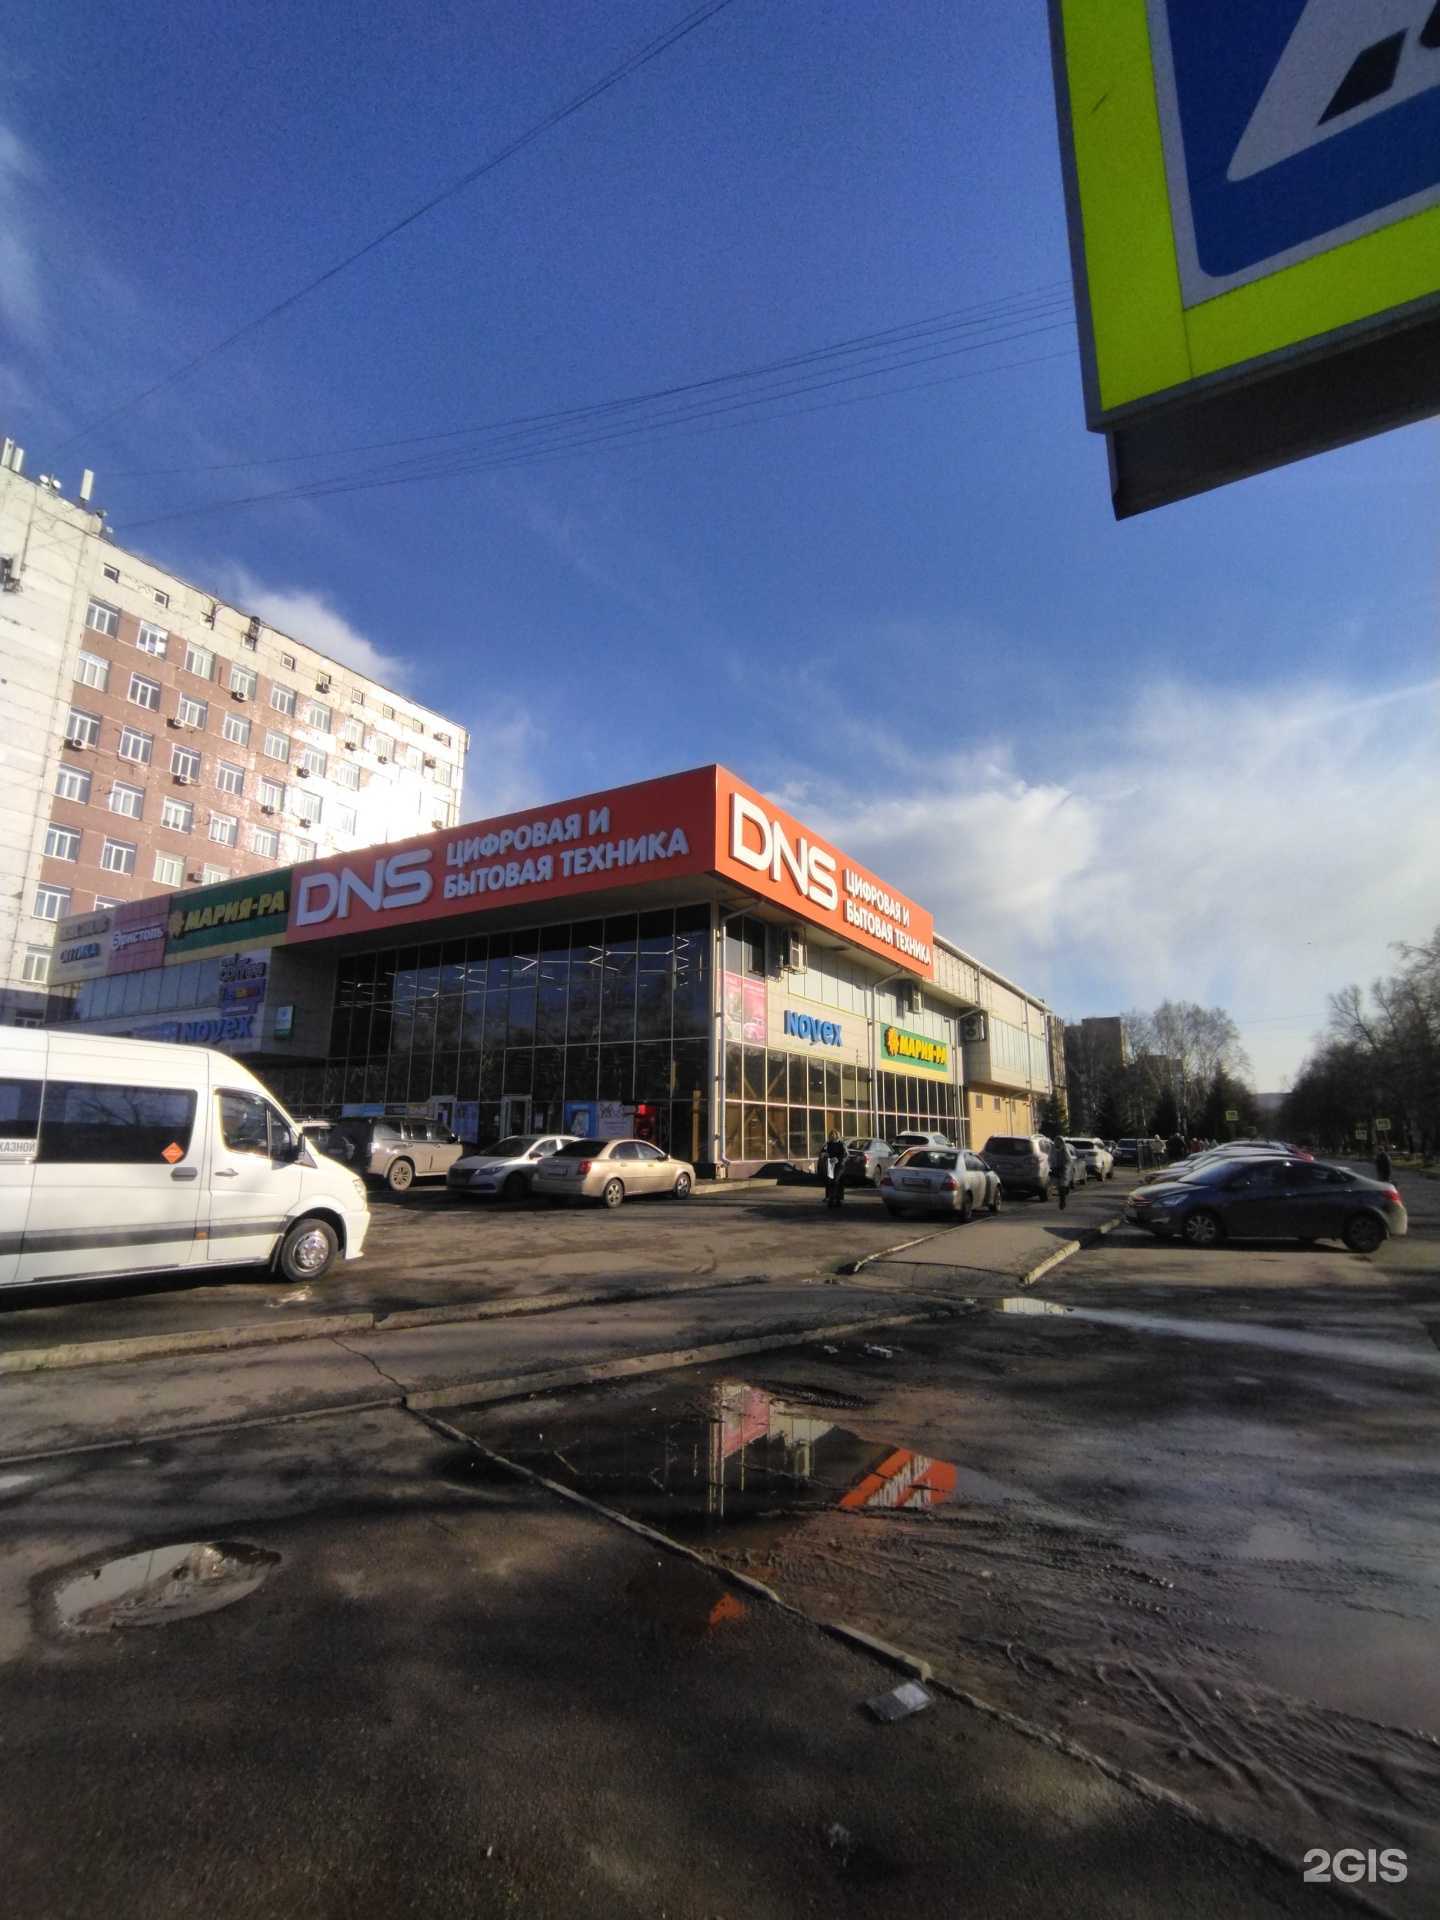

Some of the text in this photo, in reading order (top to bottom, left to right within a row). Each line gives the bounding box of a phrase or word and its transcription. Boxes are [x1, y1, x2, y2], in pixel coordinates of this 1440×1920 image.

[443, 827, 689, 899] БЫТОВАЯ ТЕХНИКА
[446, 806, 610, 868] ЦИФРОВАЯ И
[733, 792, 839, 911] DNS
[184, 889, 286, 933] МАРИЯ-РА
[296, 848, 433, 926] DNS
[842, 867, 911, 928] ЦИФРОВАЯ И
[844, 899, 931, 965] БЫТОВАЯ ТЕХНИКА
[898, 1033, 948, 1066] МАРИЯ-РА
